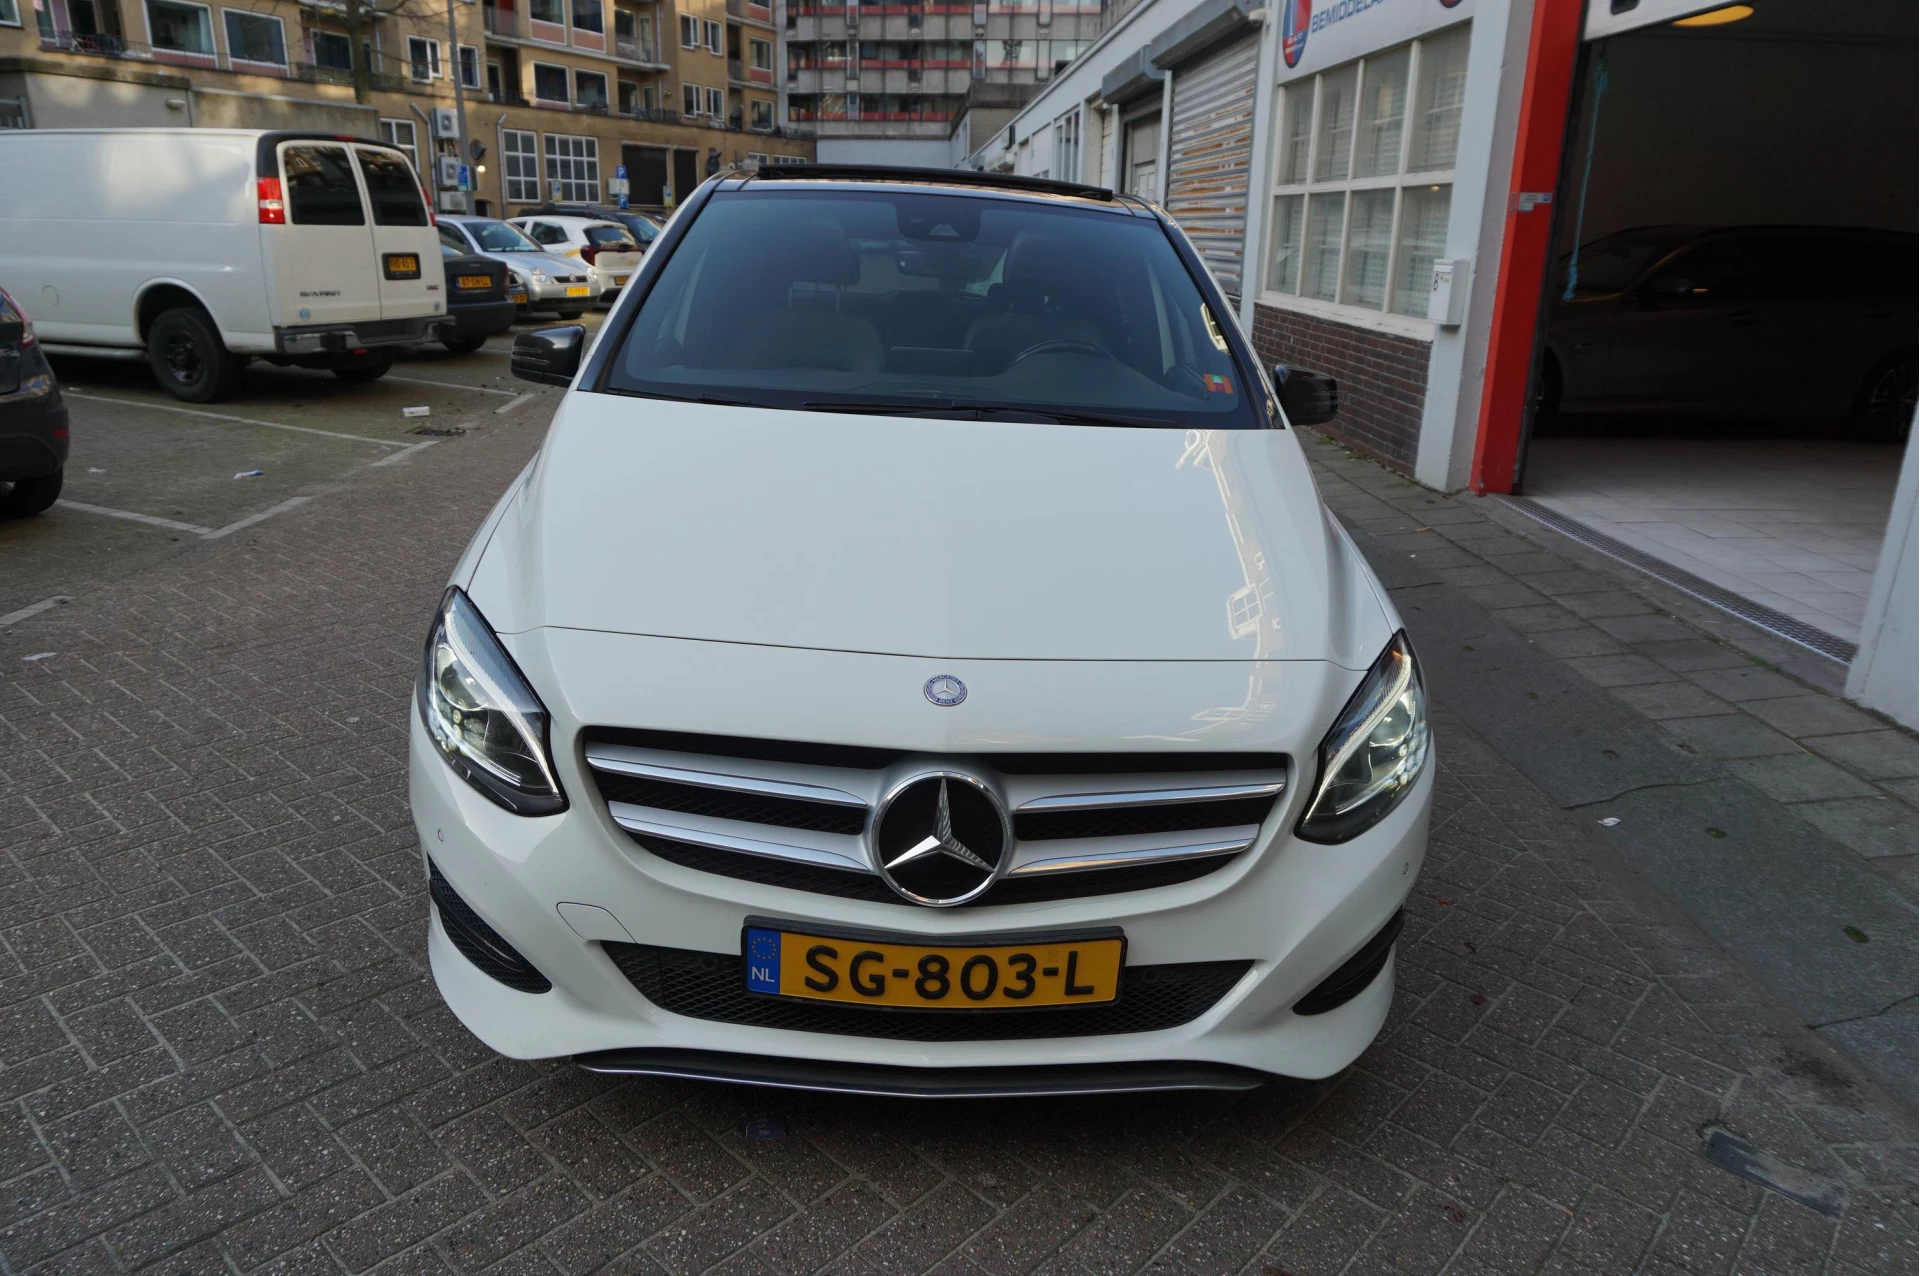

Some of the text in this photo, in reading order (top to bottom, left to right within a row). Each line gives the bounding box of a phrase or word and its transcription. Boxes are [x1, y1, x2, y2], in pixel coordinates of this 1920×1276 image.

[618, 167, 624, 178] P
[620, 194, 626, 205] P
[751, 966, 775, 983] NL
[804, 945, 1095, 1001] SG-803-L
